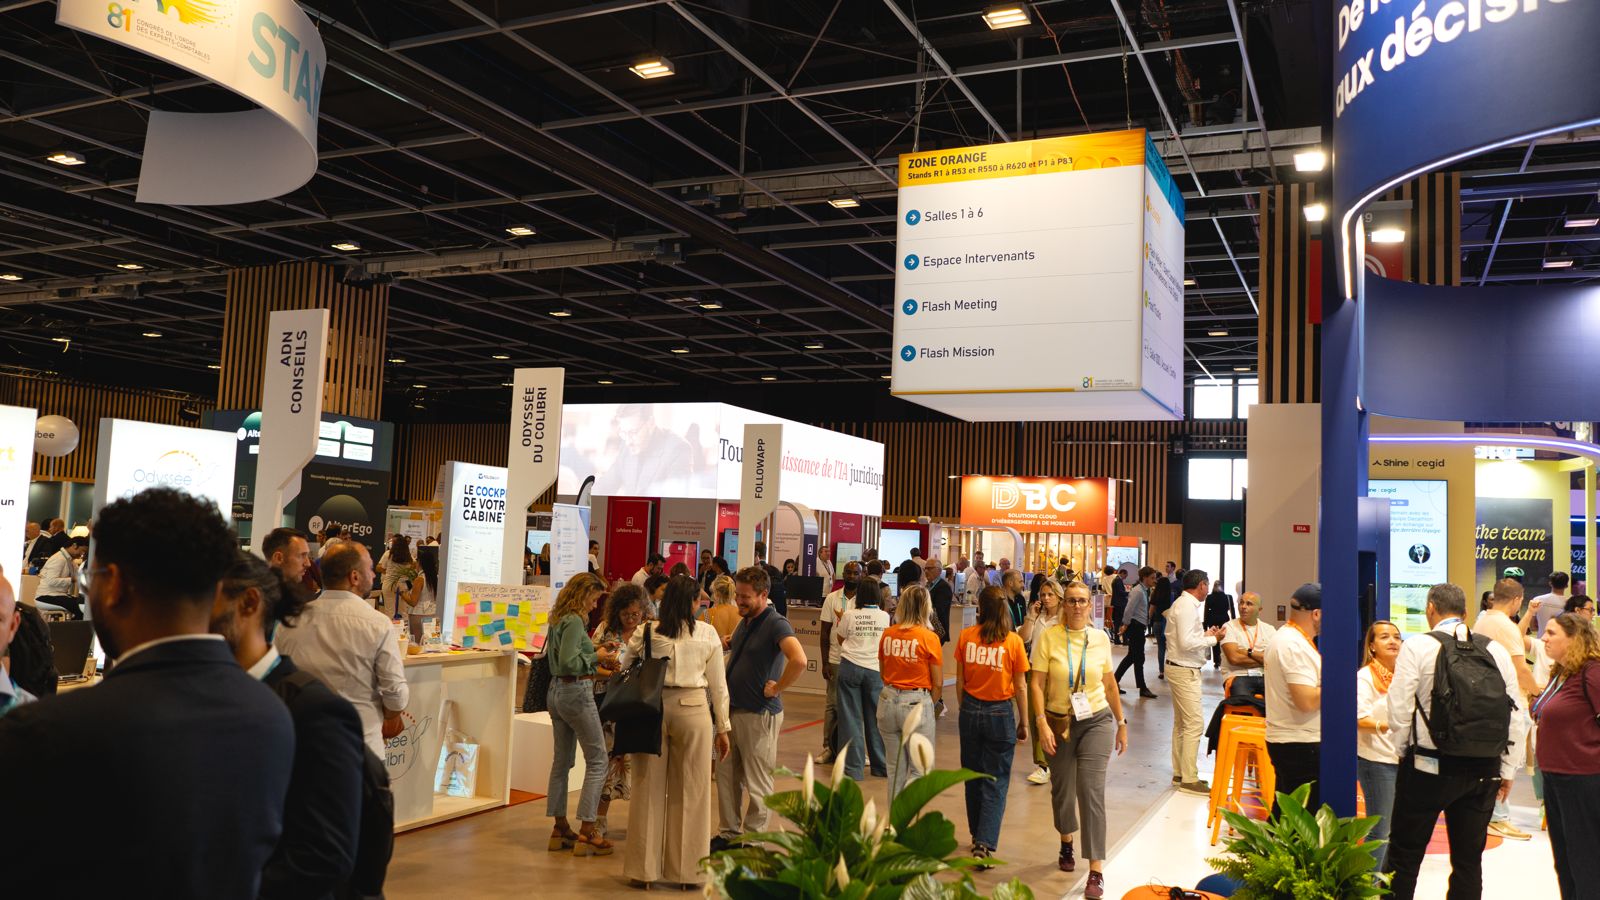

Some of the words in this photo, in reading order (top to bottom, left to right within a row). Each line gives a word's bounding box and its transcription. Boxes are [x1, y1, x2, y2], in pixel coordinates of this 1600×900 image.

[1338, 3, 1364, 51] De
[1336, 48, 1375, 118] aux
[908, 156, 937, 169] ZONE
[940, 152, 987, 165] ORANGE
[908, 171, 932, 180] Stands
[933, 169, 943, 177] R1
[945, 168, 950, 176] à
[952, 167, 967, 175] R53
[968, 166, 976, 174] et
[978, 164, 997, 173] R550
[999, 163, 1004, 171] à
[1006, 161, 1027, 170] R620
[1028, 161, 1037, 169] et
[1038, 159, 1048, 168] P1
[1050, 158, 1055, 166] à
[1057, 157, 1073, 166] P83
[924, 210, 958, 222] Salles
[961, 209, 965, 219] 1
[967, 206, 974, 219] à
[977, 207, 984, 218] 6
[923, 254, 962, 268] Espace
[965, 250, 1035, 264] Intervenants
[922, 301, 951, 312] Flash
[954, 299, 997, 312] Meeting
[281, 331, 293, 367] ADN
[920, 347, 949, 358] Flash
[953, 346, 995, 358] Mission
[291, 330, 307, 414] CONSEILS
[1083, 376, 1093, 388] 81
[522, 387, 535, 447] ODYSSÉE
[535, 387, 547, 440] COLIBRI
[533, 444, 543, 463] DU
[1383, 458, 1409, 467] Shine
[720, 438, 743, 463] Tou
[821, 458, 832, 478] de
[834, 460, 848, 481] l'IA
[849, 463, 884, 490] juridiqu
[755, 438, 766, 499] FOLLOWAPP
[1416, 459, 1445, 470] cegid
[464, 484, 474, 495] LE
[992, 482, 1077, 512] DBC
[464, 497, 476, 508] DE
[479, 498, 505, 511] VOTR
[463, 509, 505, 523] CABINE
[325, 521, 373, 537] AerEgo
[1232, 526, 1241, 537] S
[1475, 523, 1499, 540] the
[1502, 527, 1546, 541] team
[1475, 543, 1499, 560] the
[1502, 545, 1546, 561] team
[795, 627, 819, 635] Informa
[883, 636, 919, 658] Dext
[965, 642, 1006, 668] Dext
